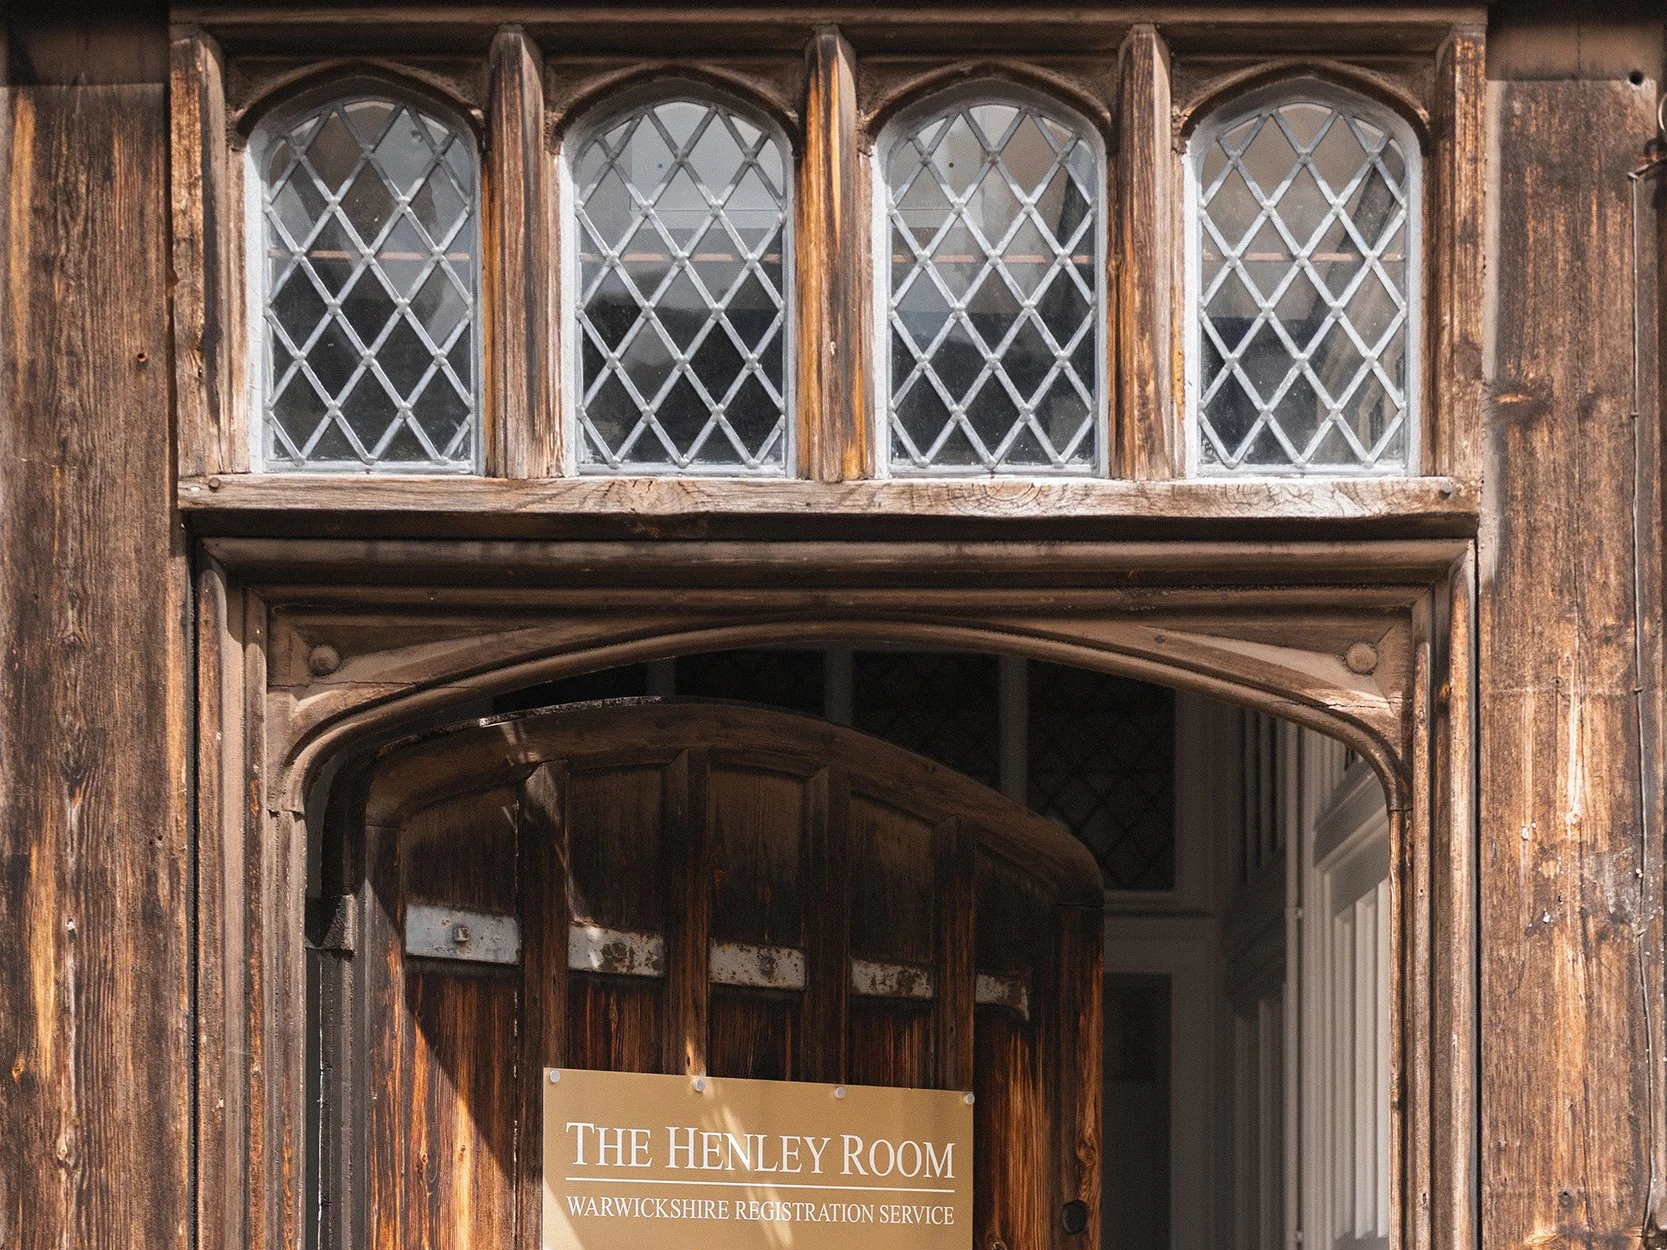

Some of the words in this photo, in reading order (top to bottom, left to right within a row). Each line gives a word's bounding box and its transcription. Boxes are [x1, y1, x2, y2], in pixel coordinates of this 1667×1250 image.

[566, 1122, 652, 1167] THE
[665, 1126, 831, 1174] HENLEY
[840, 1135, 955, 1178] ROOM
[567, 1196, 729, 1220] WARWICKSHIRE
[735, 1201, 874, 1223] REGISTRATION
[879, 1206, 954, 1225] SERVICE
